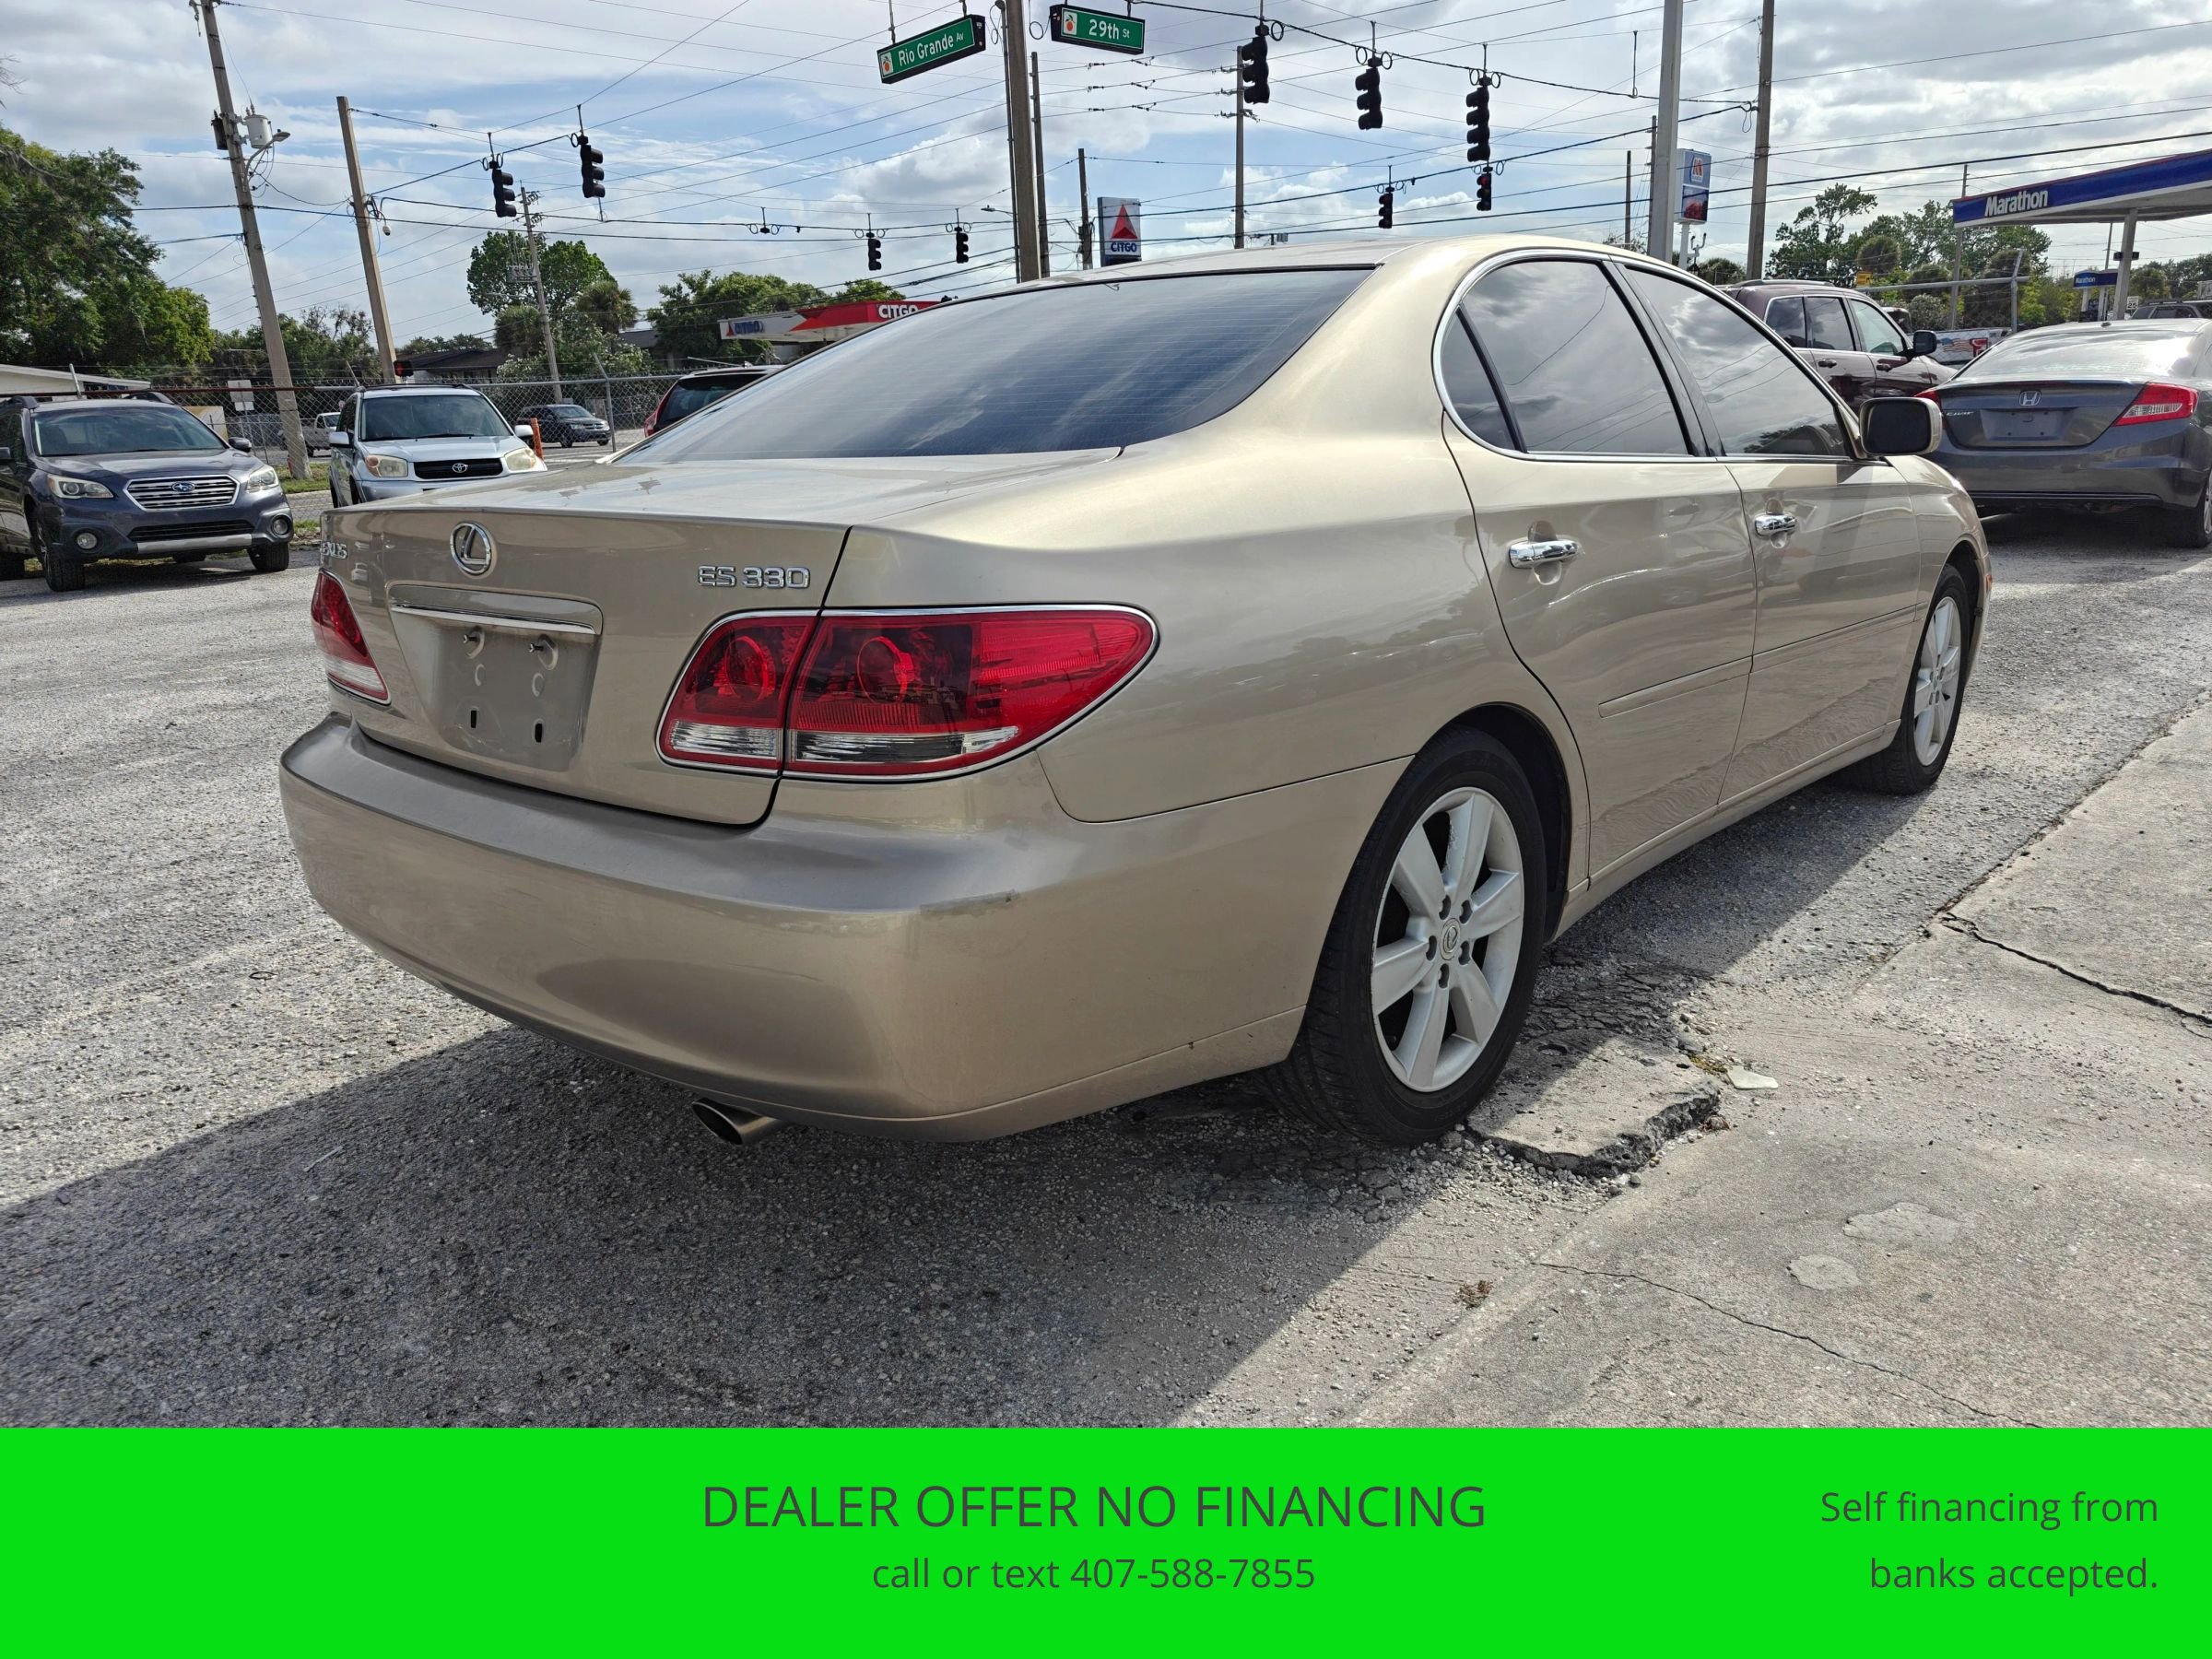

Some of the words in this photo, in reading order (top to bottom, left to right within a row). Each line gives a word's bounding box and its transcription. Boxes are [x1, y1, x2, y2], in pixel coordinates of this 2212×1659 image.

[1088, 18, 1120, 40] 29th
[1122, 28, 1130, 39] St
[899, 49, 914, 66] Rio
[917, 34, 954, 60] Grande
[957, 31, 964, 42] Av
[1984, 190, 2048, 217] Marathon
[1111, 242, 1137, 253] CITGO
[698, 565, 736, 587] ES
[742, 566, 811, 588] 330
